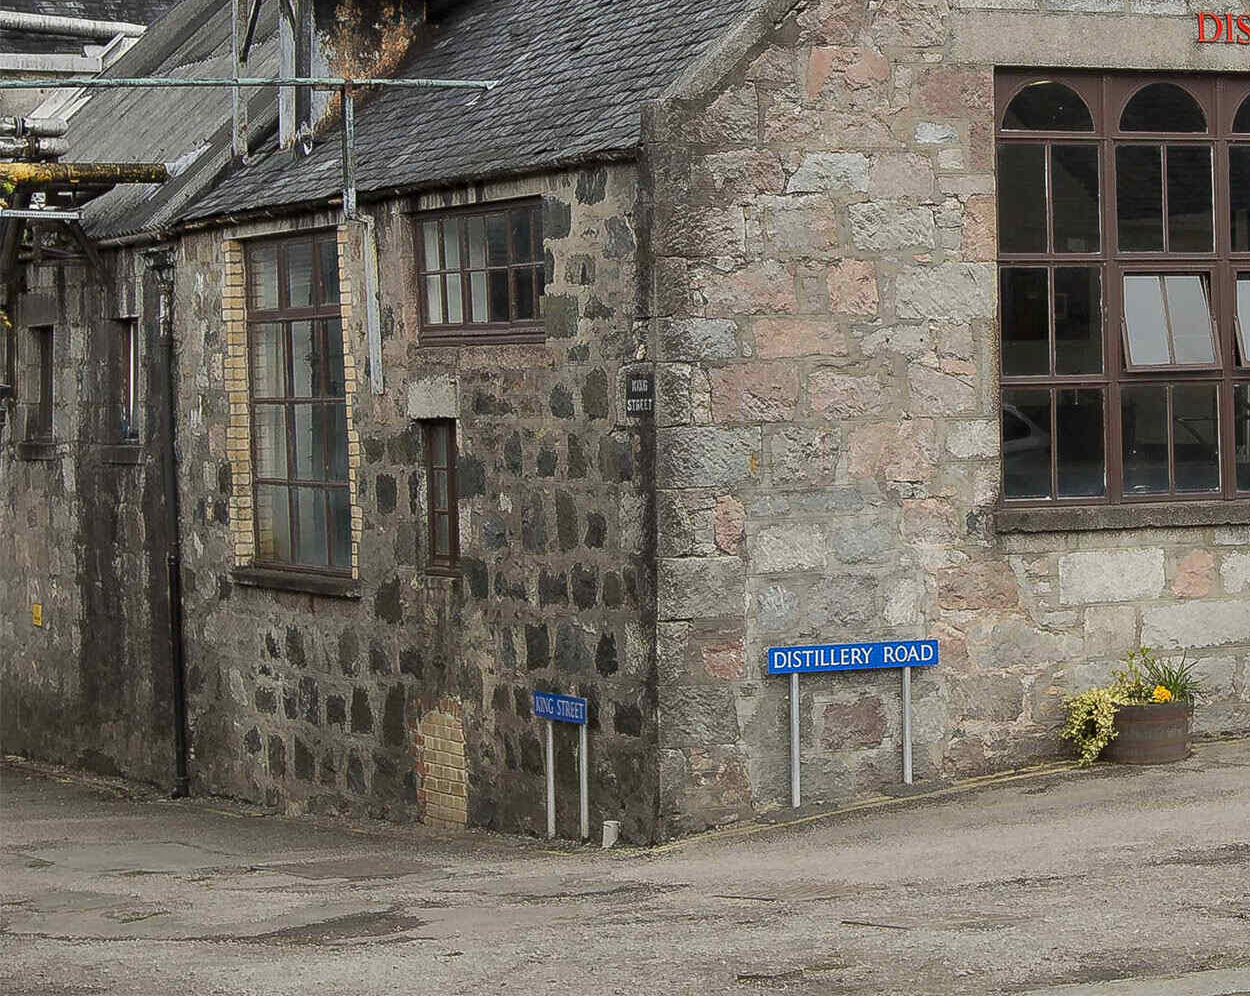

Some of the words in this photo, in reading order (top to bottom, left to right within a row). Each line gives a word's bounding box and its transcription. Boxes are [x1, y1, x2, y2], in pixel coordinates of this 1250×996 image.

[626, 398, 653, 412] STREET
[773, 646, 873, 669] DISTILLERY
[883, 644, 934, 664] ROAD
[556, 699, 585, 720] STREET
